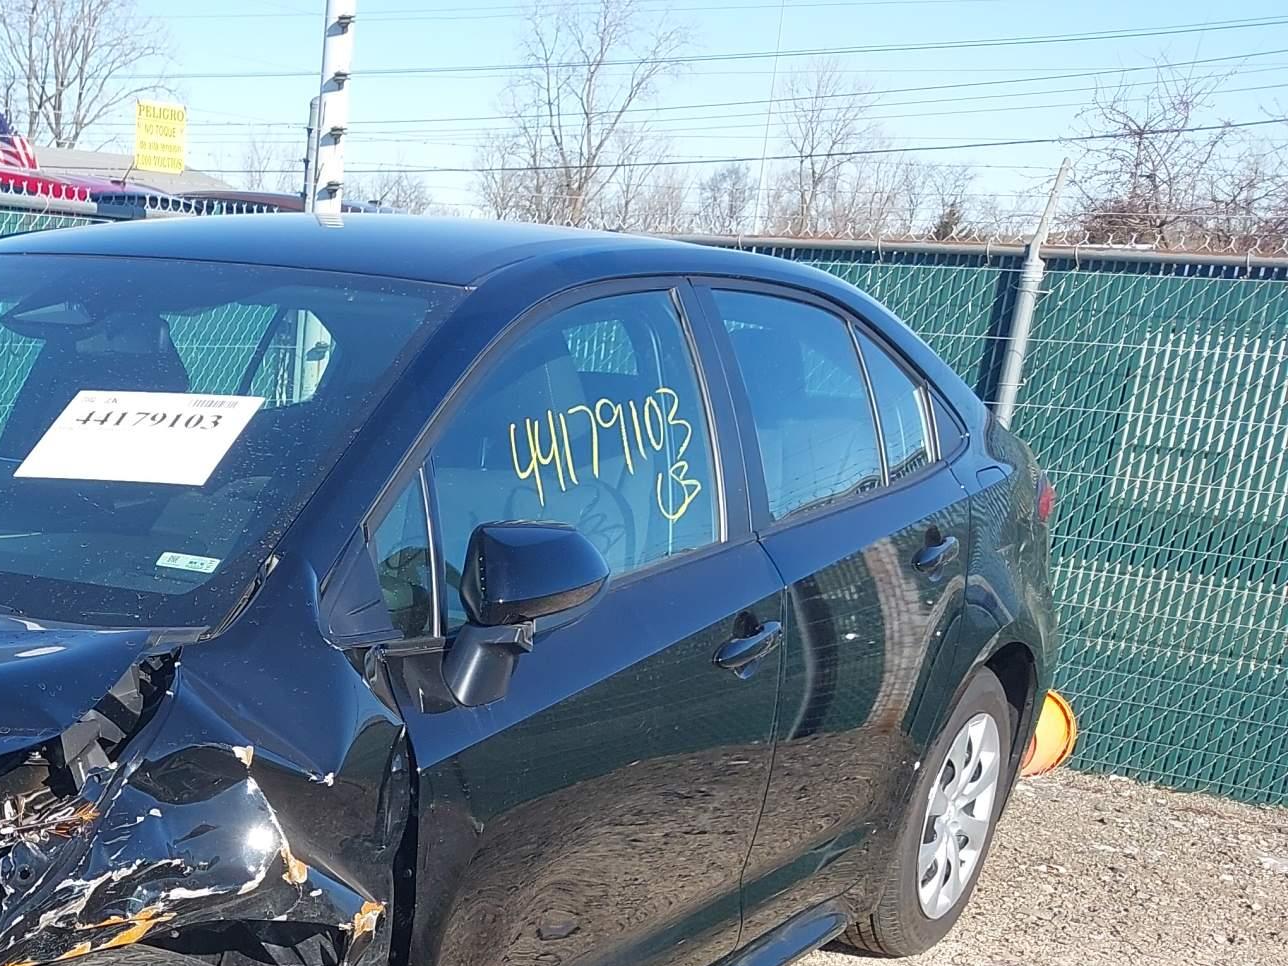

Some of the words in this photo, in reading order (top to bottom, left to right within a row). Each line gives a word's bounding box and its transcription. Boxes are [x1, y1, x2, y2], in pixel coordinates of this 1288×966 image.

[137, 104, 185, 122] PELIGRO
[156, 124, 177, 138] TOQUE
[75, 410, 224, 430] 44179103
[509, 387, 693, 507] 44179103
